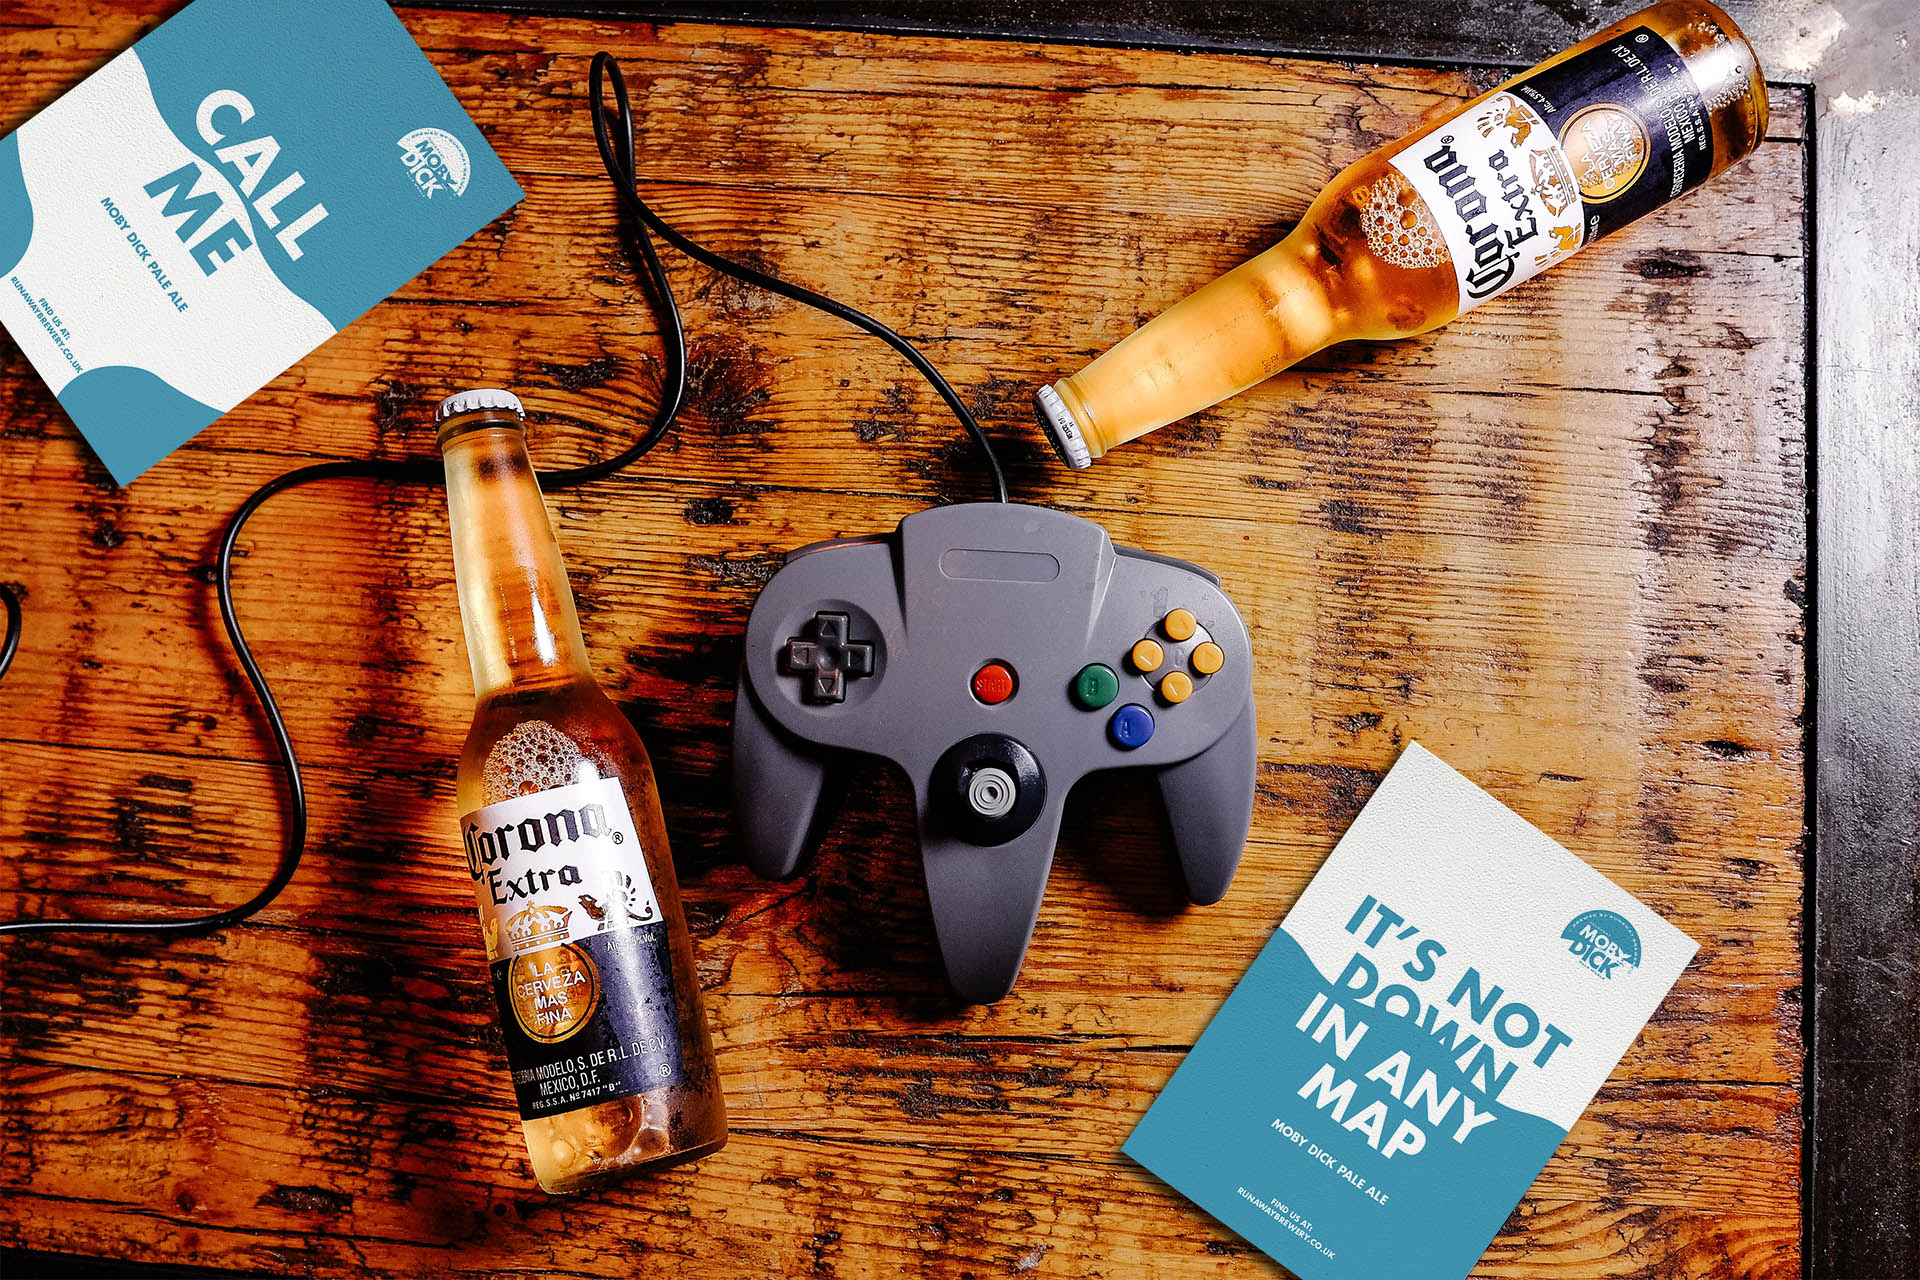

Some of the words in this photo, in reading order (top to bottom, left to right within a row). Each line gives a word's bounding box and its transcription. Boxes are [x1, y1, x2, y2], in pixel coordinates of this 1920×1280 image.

[1623, 54, 1640, 67] DE
[1645, 81, 1661, 97] DE
[415, 140, 458, 185] MOBY
[1581, 152, 1595, 171] LA
[1582, 119, 1617, 190] CERVEZA
[1604, 131, 1625, 168] MAS
[1617, 120, 1639, 164] FINA
[196, 89, 329, 261] CALL
[400, 152, 444, 199] DICK
[143, 162, 253, 277] ME
[1488, 149, 1538, 249] Extra
[101, 197, 131, 230] MOBY
[126, 232, 152, 261] DICK
[147, 261, 172, 290] PALE
[167, 291, 188, 312] ALE
[10, 276, 83, 373] RUNAWAYBREWERY.CO.UK
[38, 297, 54, 316] FIND
[52, 316, 62, 327] US
[60, 328, 70, 340] AT:
[487, 865, 582, 906] Extra
[1568, 940, 1619, 979] DICK
[1579, 924, 1632, 960] MOBY
[516, 972, 587, 998] CERVEZA
[533, 962, 554, 977] LA
[534, 991, 568, 1010] MAS
[536, 1007, 573, 1026] FINA
[1446, 967, 1573, 1069] NOT
[1333, 952, 1519, 1103] DOWN
[536, 1058, 578, 1080] MODELO,
[578, 1057, 589, 1071] S.
[590, 1052, 605, 1067] DE
[632, 1040, 648, 1056] DE
[1295, 991, 1369, 1060] IN
[1365, 1048, 1497, 1144] ANY
[539, 1073, 580, 1096] MEXICO,
[580, 1069, 601, 1087] D.F.
[582, 1087, 600, 1100] 7417
[1297, 1063, 1426, 1160] MAP
[1271, 1118, 1309, 1147] MOBY
[1307, 1144, 1337, 1169] DICK
[1337, 1165, 1366, 1190] PALE
[1364, 1186, 1389, 1206] ALE
[1236, 1186, 1336, 1259] RUNAWAYBREWERY.CO.UK
[1270, 1198, 1289, 1214] FIND
[1289, 1211, 1301, 1222] US
[1300, 1220, 1313, 1232] AT:
